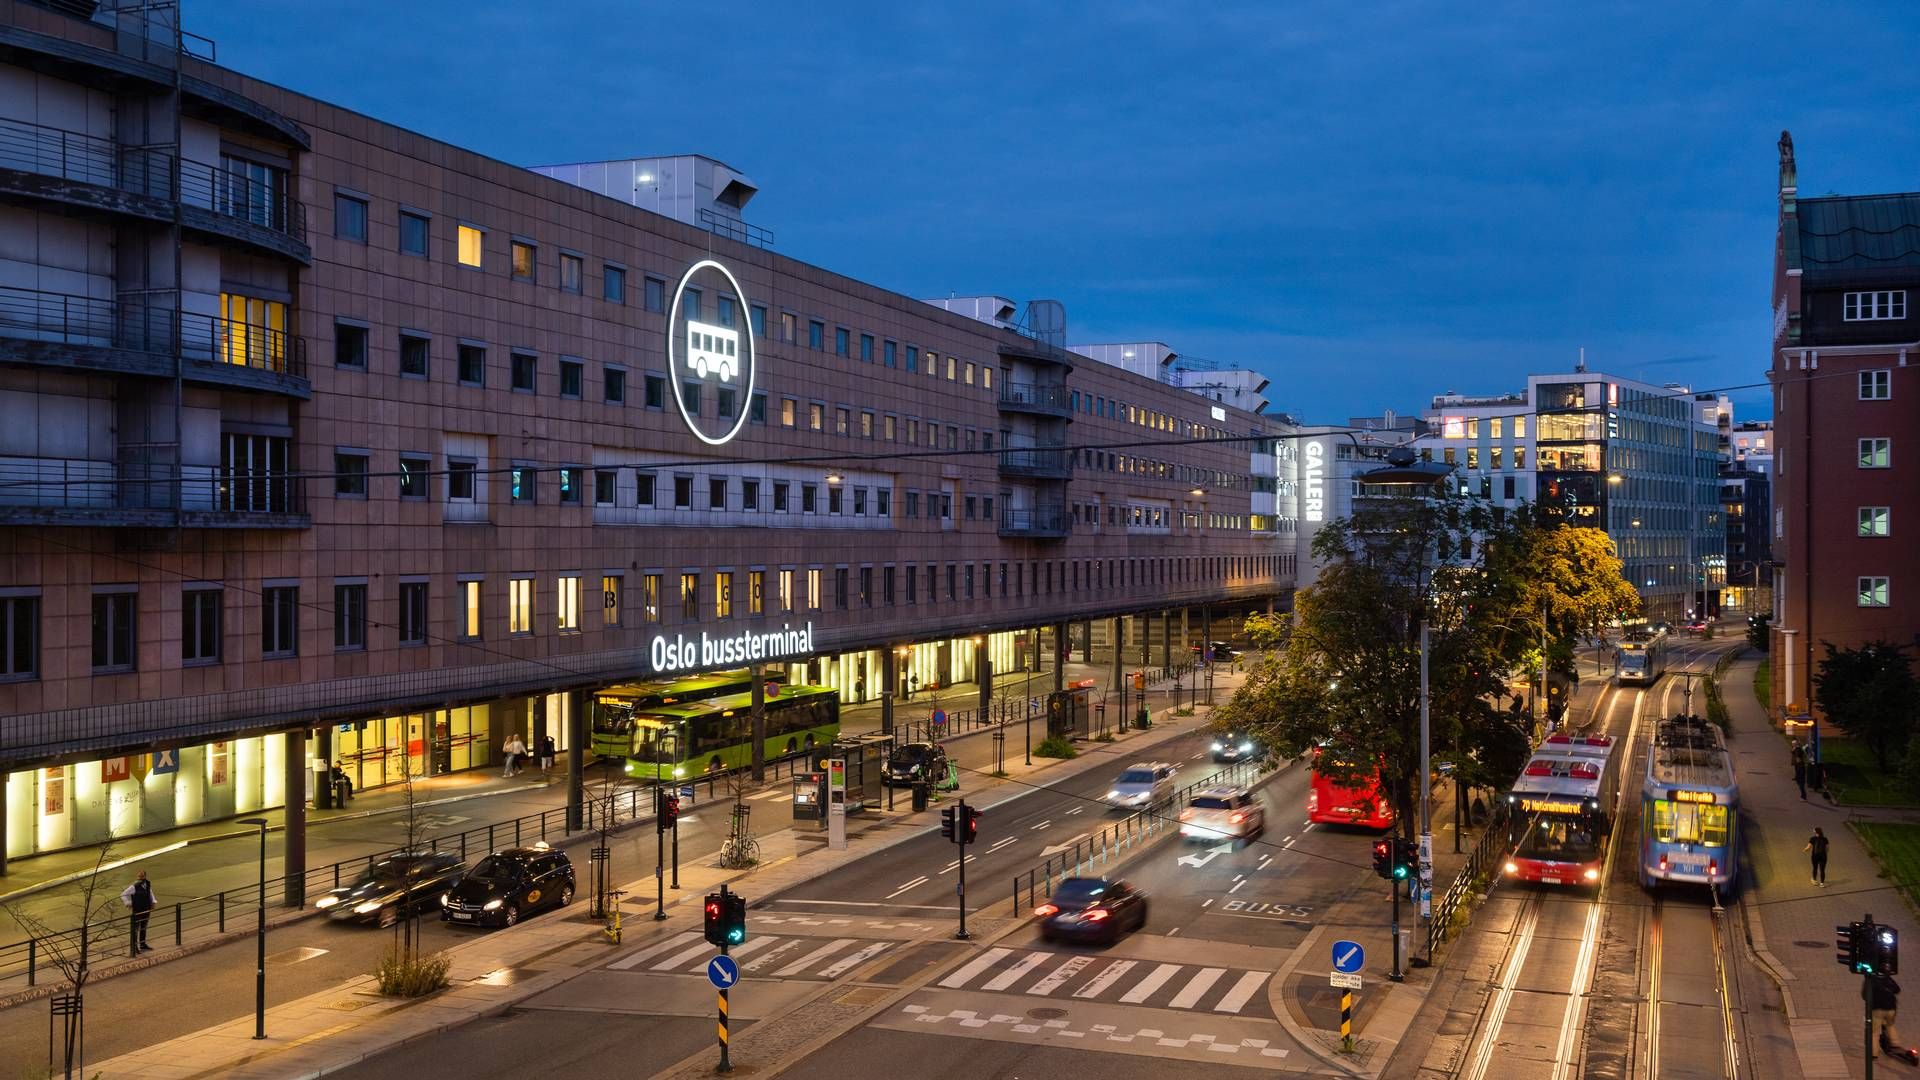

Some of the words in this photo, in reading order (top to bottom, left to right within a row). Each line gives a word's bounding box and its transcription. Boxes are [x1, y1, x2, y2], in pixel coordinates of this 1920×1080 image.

[651, 634, 696, 672] Oslo
[702, 621, 813, 666] bussterminal
[1521, 800, 1531, 810] 70
[1222, 900, 1313, 917] BUSS
